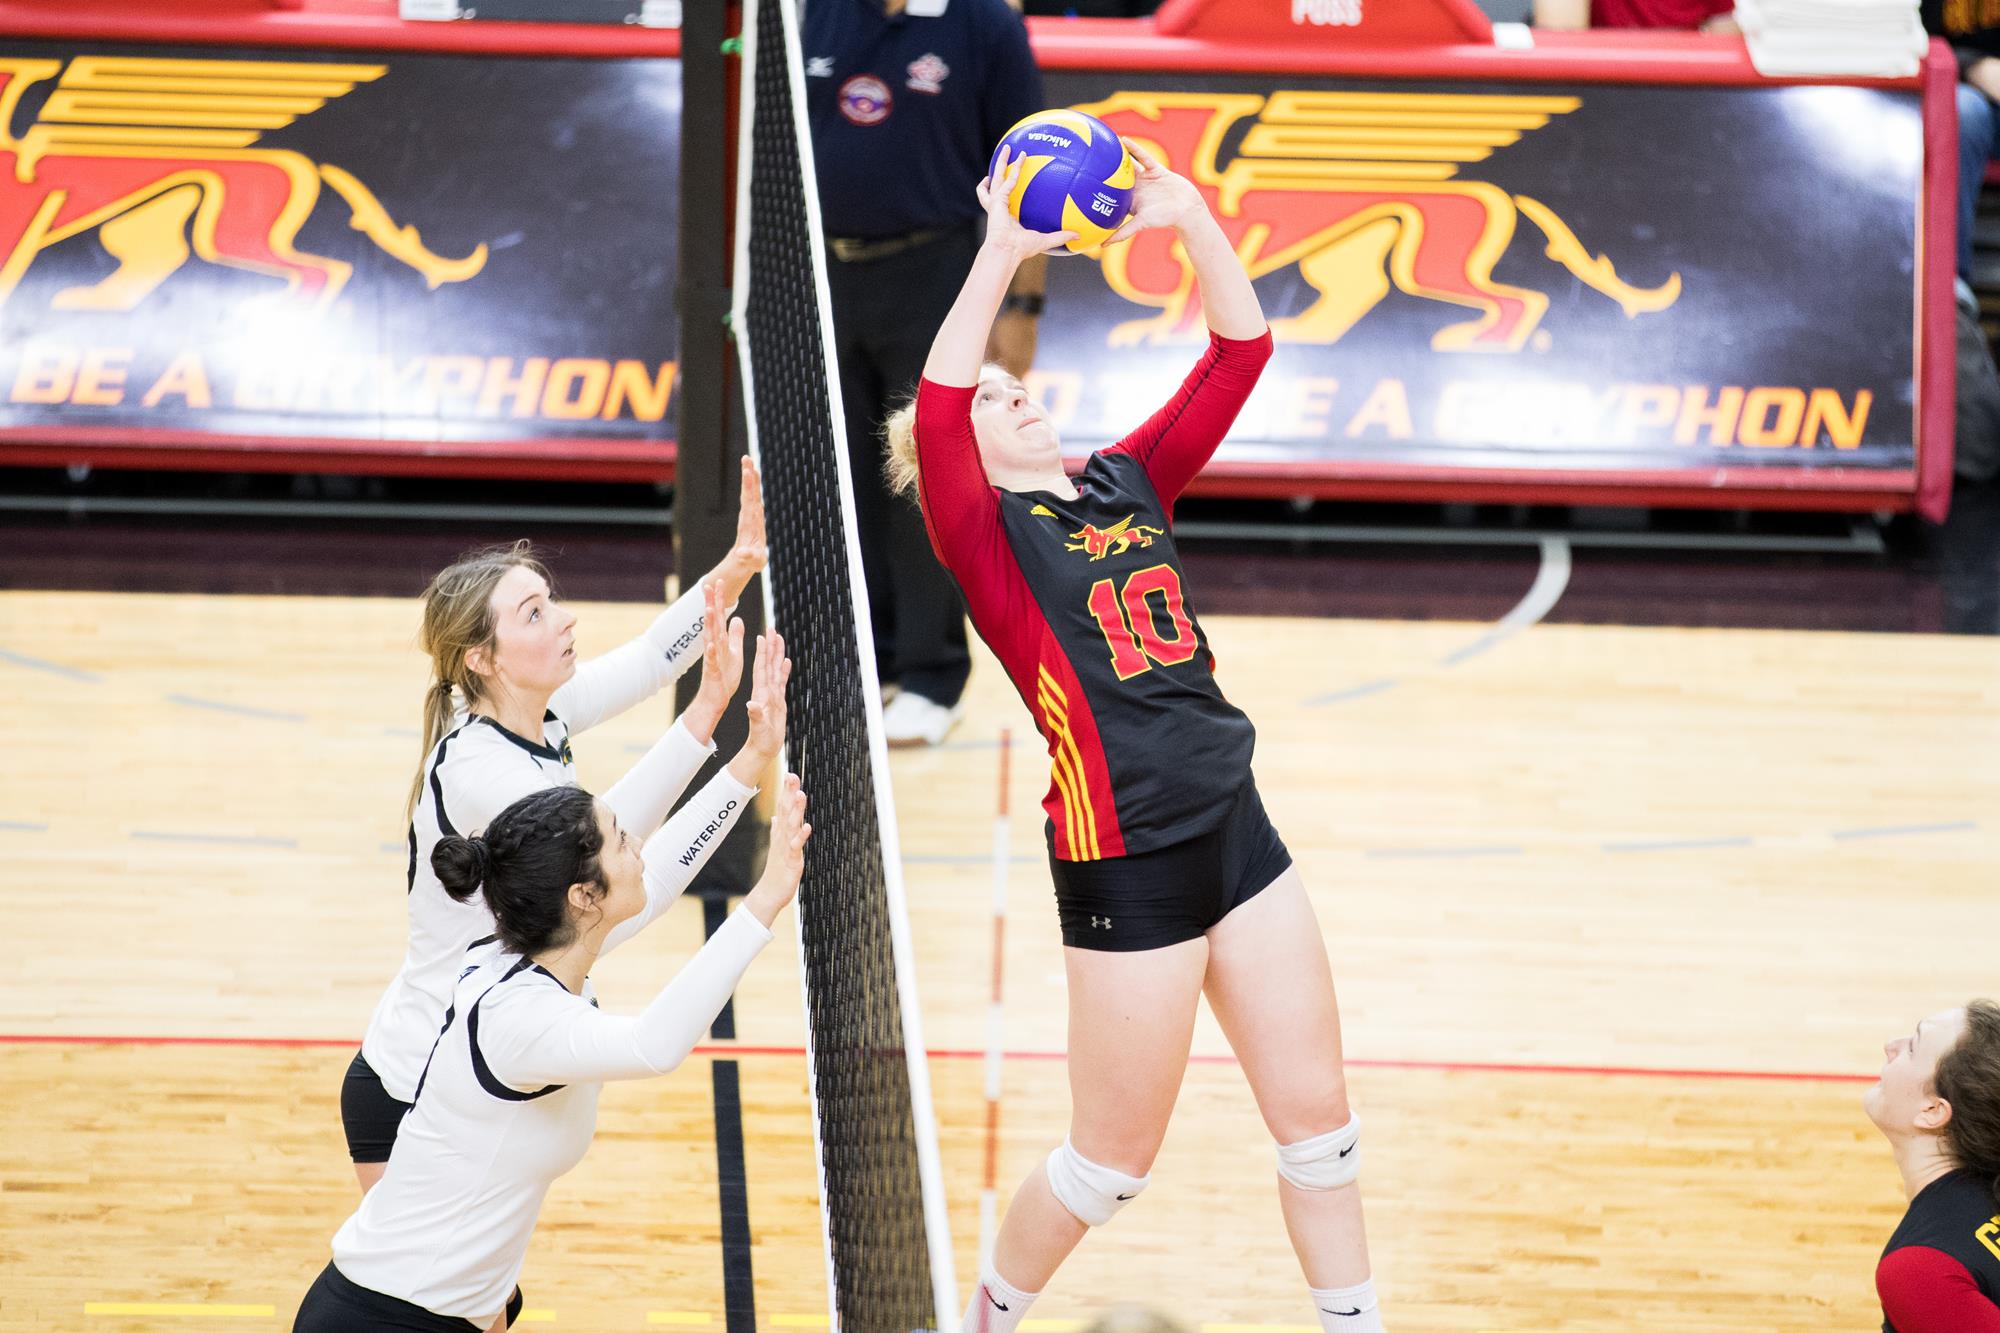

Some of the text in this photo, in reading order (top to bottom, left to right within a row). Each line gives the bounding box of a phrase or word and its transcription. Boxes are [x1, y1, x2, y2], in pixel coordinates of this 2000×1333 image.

[1091, 199, 1115, 217] FIVB
[10, 346, 134, 406] BE
[141, 350, 213, 409] A
[1345, 378, 1413, 440] A
[1087, 563, 1198, 681] 10
[679, 799, 738, 868] WATERLOO
